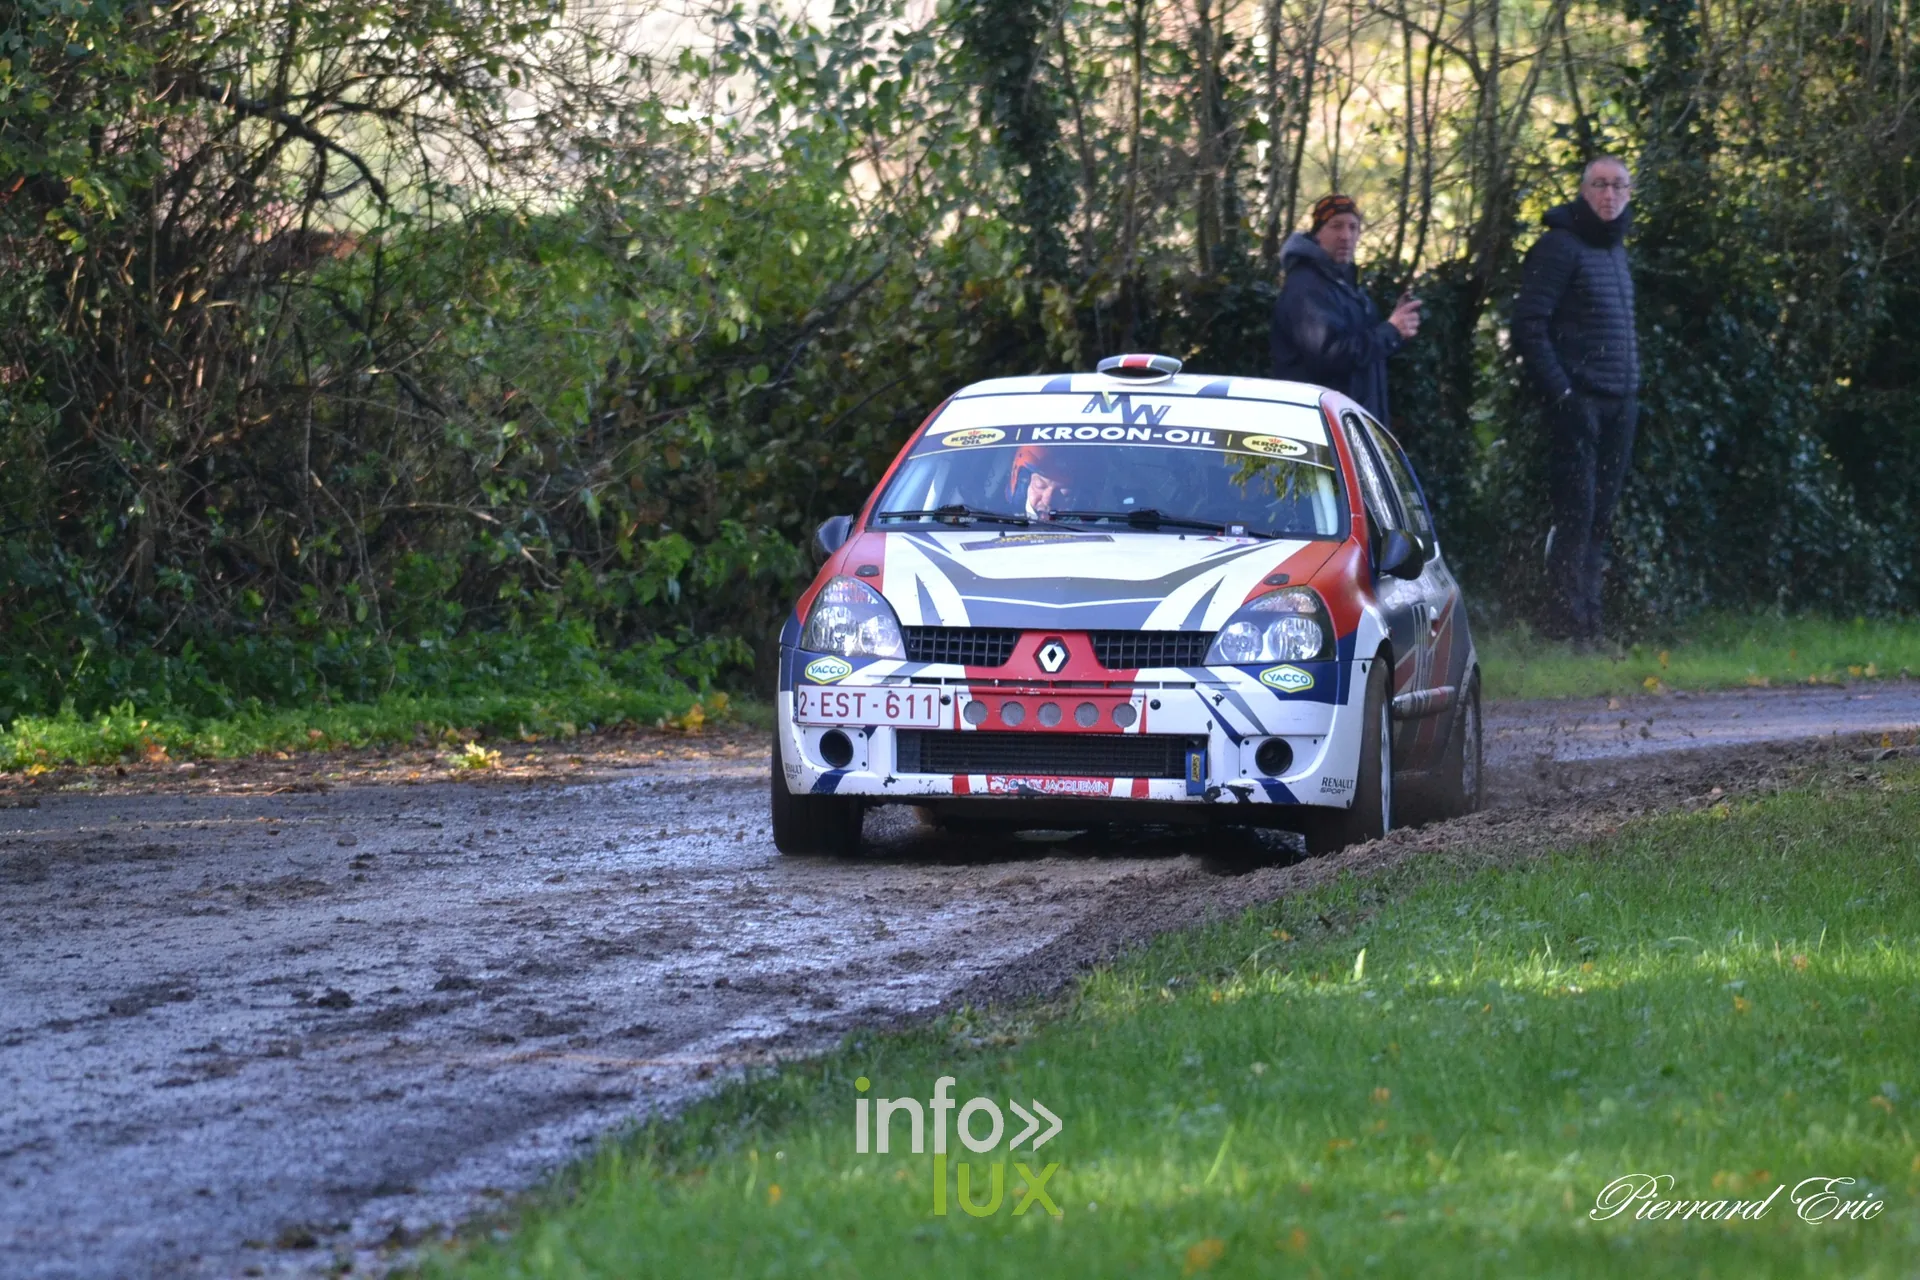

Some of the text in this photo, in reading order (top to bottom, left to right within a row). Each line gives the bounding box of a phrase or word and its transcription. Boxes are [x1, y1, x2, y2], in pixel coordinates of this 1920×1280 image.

[950, 433, 997, 442] KROON
[1031, 426, 1216, 446] KROON-OIL
[1251, 439, 1298, 452] KROON
[1263, 446, 1284, 454] OIL
[811, 665, 846, 675] YACCO
[1267, 673, 1309, 684] YACCO
[1321, 776, 1355, 789] RENAULT
[1319, 787, 1346, 795] SPORT
